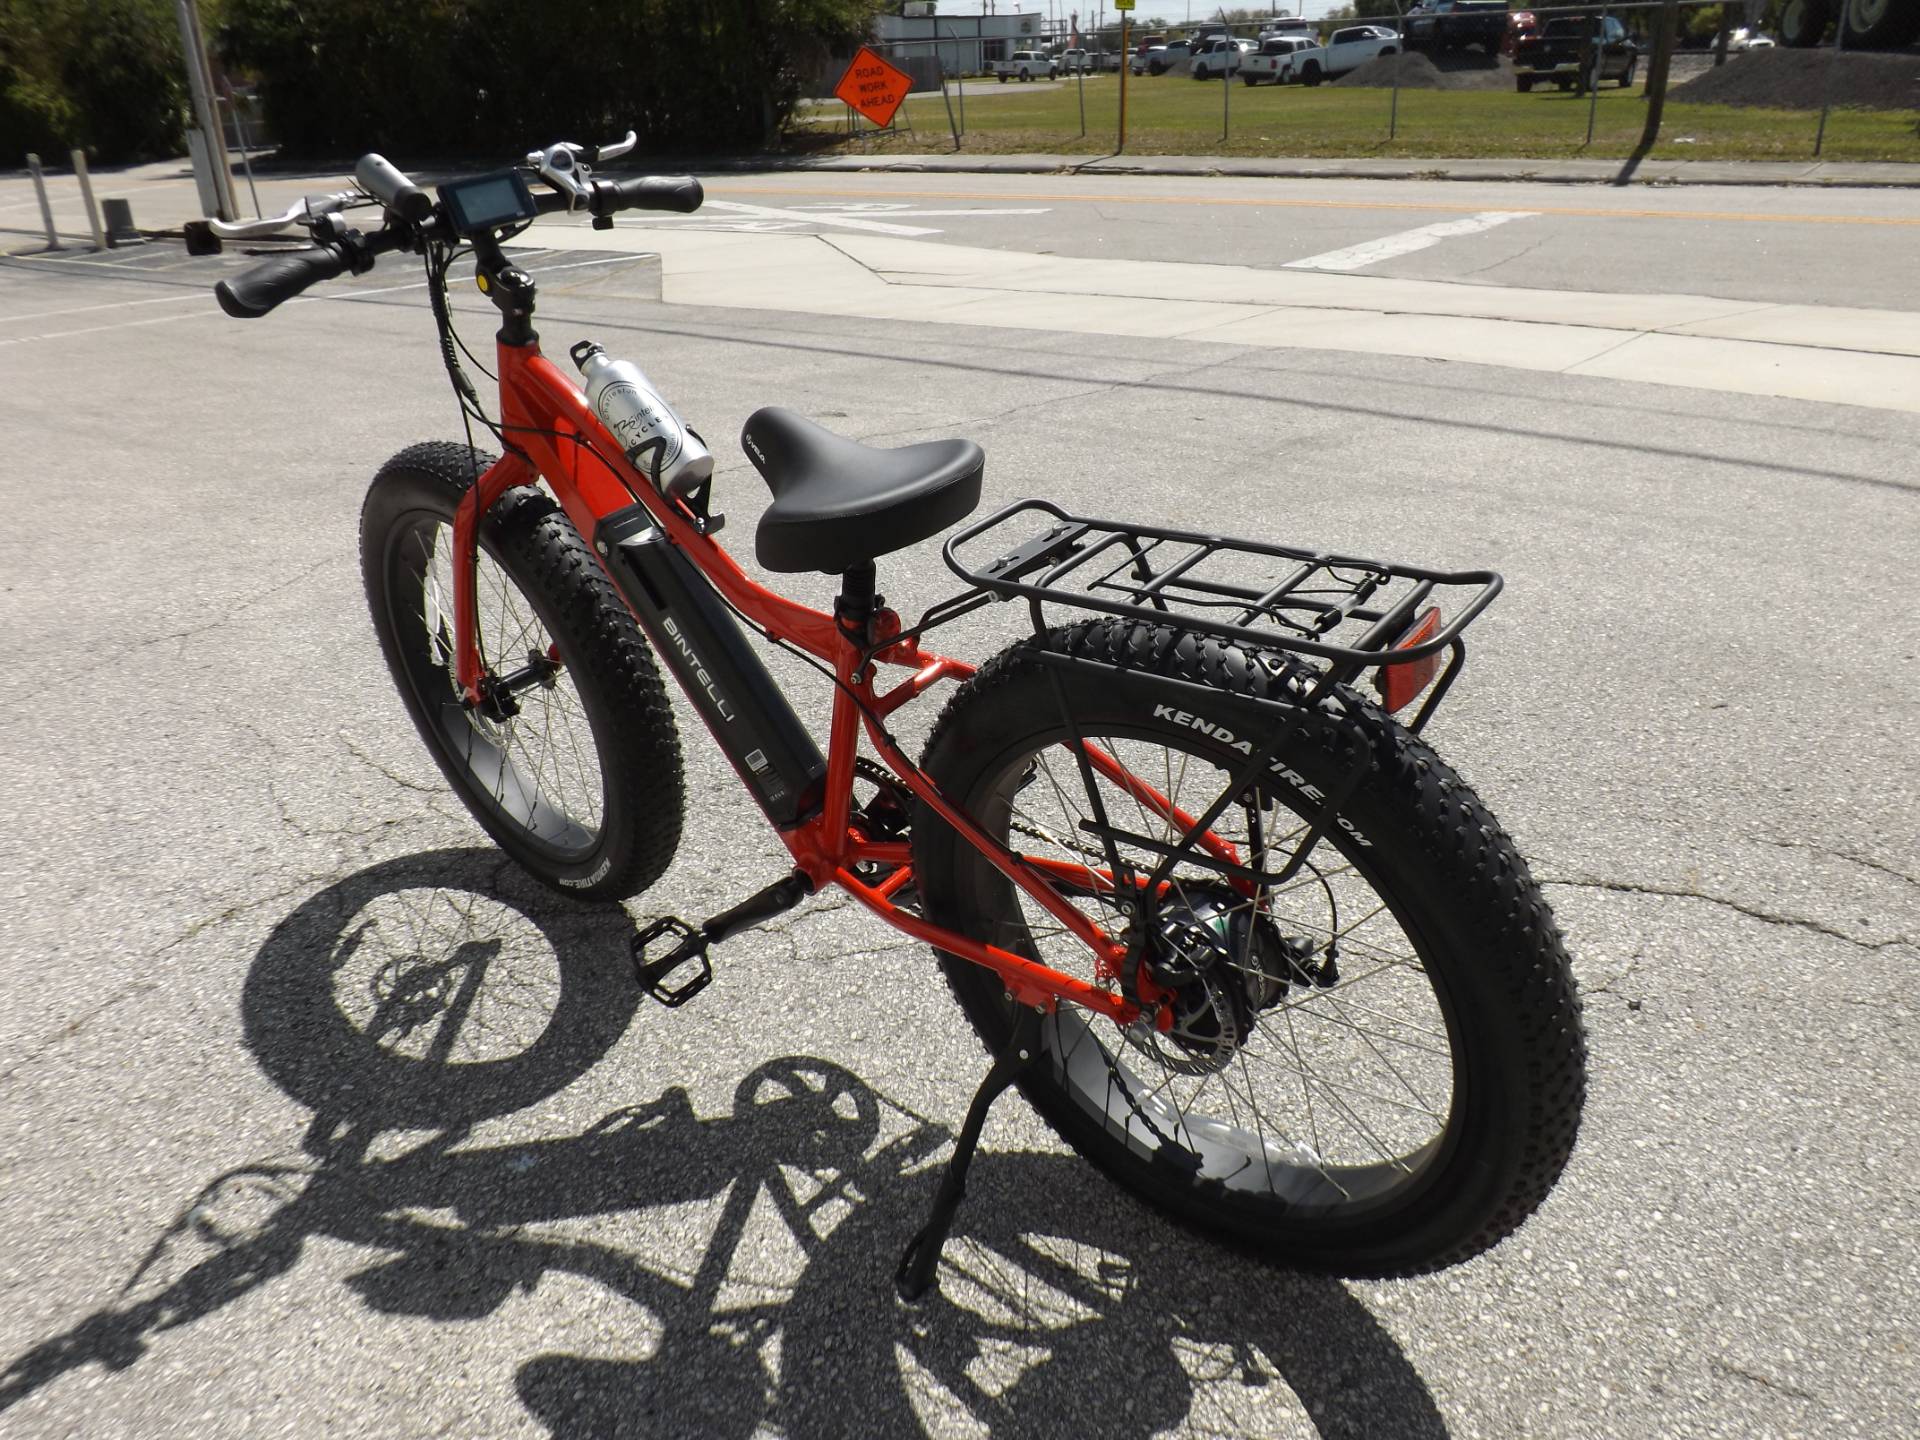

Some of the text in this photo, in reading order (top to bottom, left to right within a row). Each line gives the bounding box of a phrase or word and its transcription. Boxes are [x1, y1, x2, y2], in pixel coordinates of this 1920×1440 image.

[855, 66, 884, 79] ROAD
[859, 80, 888, 93] WORK
[860, 94, 895, 108] AHEAD
[662, 616, 735, 723] BINTELLI
